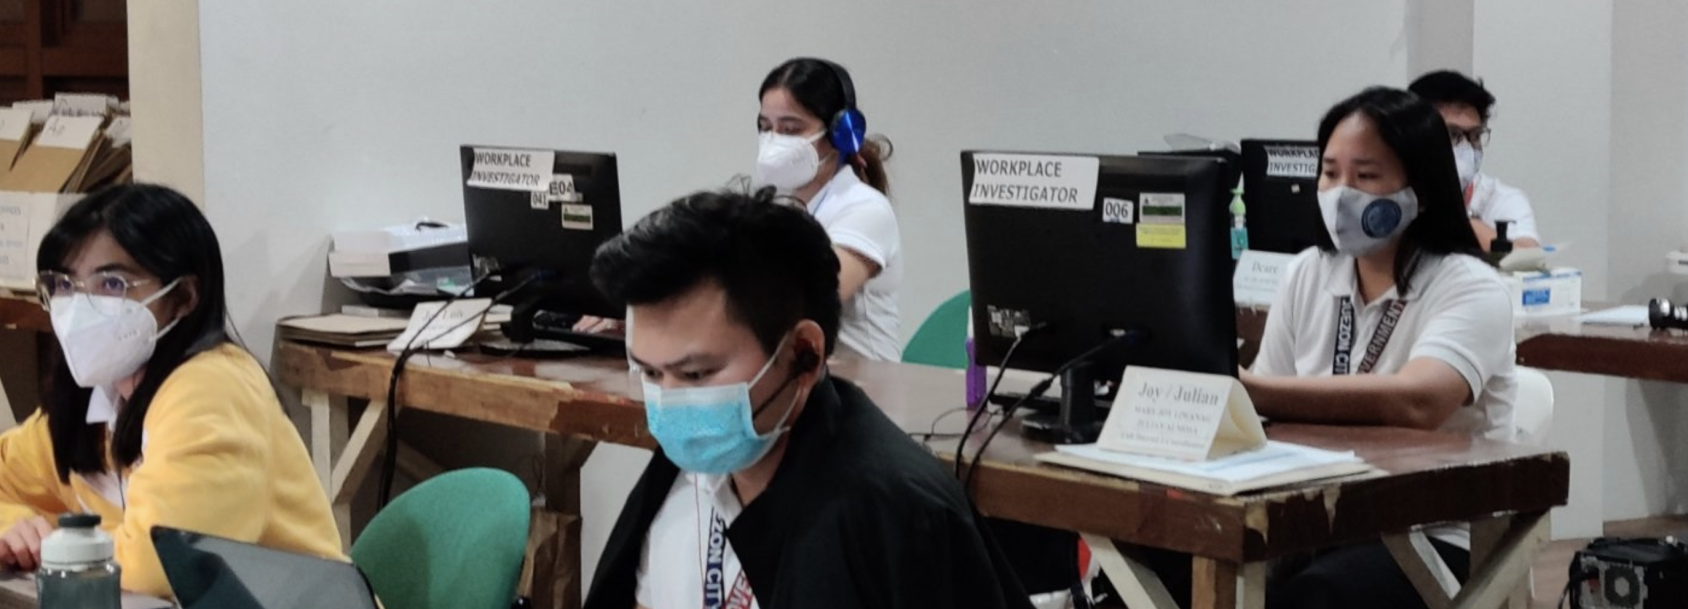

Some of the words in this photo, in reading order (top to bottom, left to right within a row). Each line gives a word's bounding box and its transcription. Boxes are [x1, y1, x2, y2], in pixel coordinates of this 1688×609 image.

[474, 151, 532, 168] WORKPLACE
[1269, 148, 1319, 158] WORKPLAC
[975, 158, 1063, 178] WORKPLACE
[1269, 161, 1317, 174] INVESTIG
[472, 171, 540, 187] INVESTIGATOR
[973, 182, 1079, 204] INVESTIGATOR
[1105, 201, 1129, 219] 006
[1338, 299, 1352, 351] UEZON
[1358, 300, 1406, 373] VERNMENT
[1334, 353, 1350, 375] CIT
[1138, 382, 1160, 403] Joy
[1174, 386, 1219, 406] Julian
[709, 513, 724, 564] ZON
